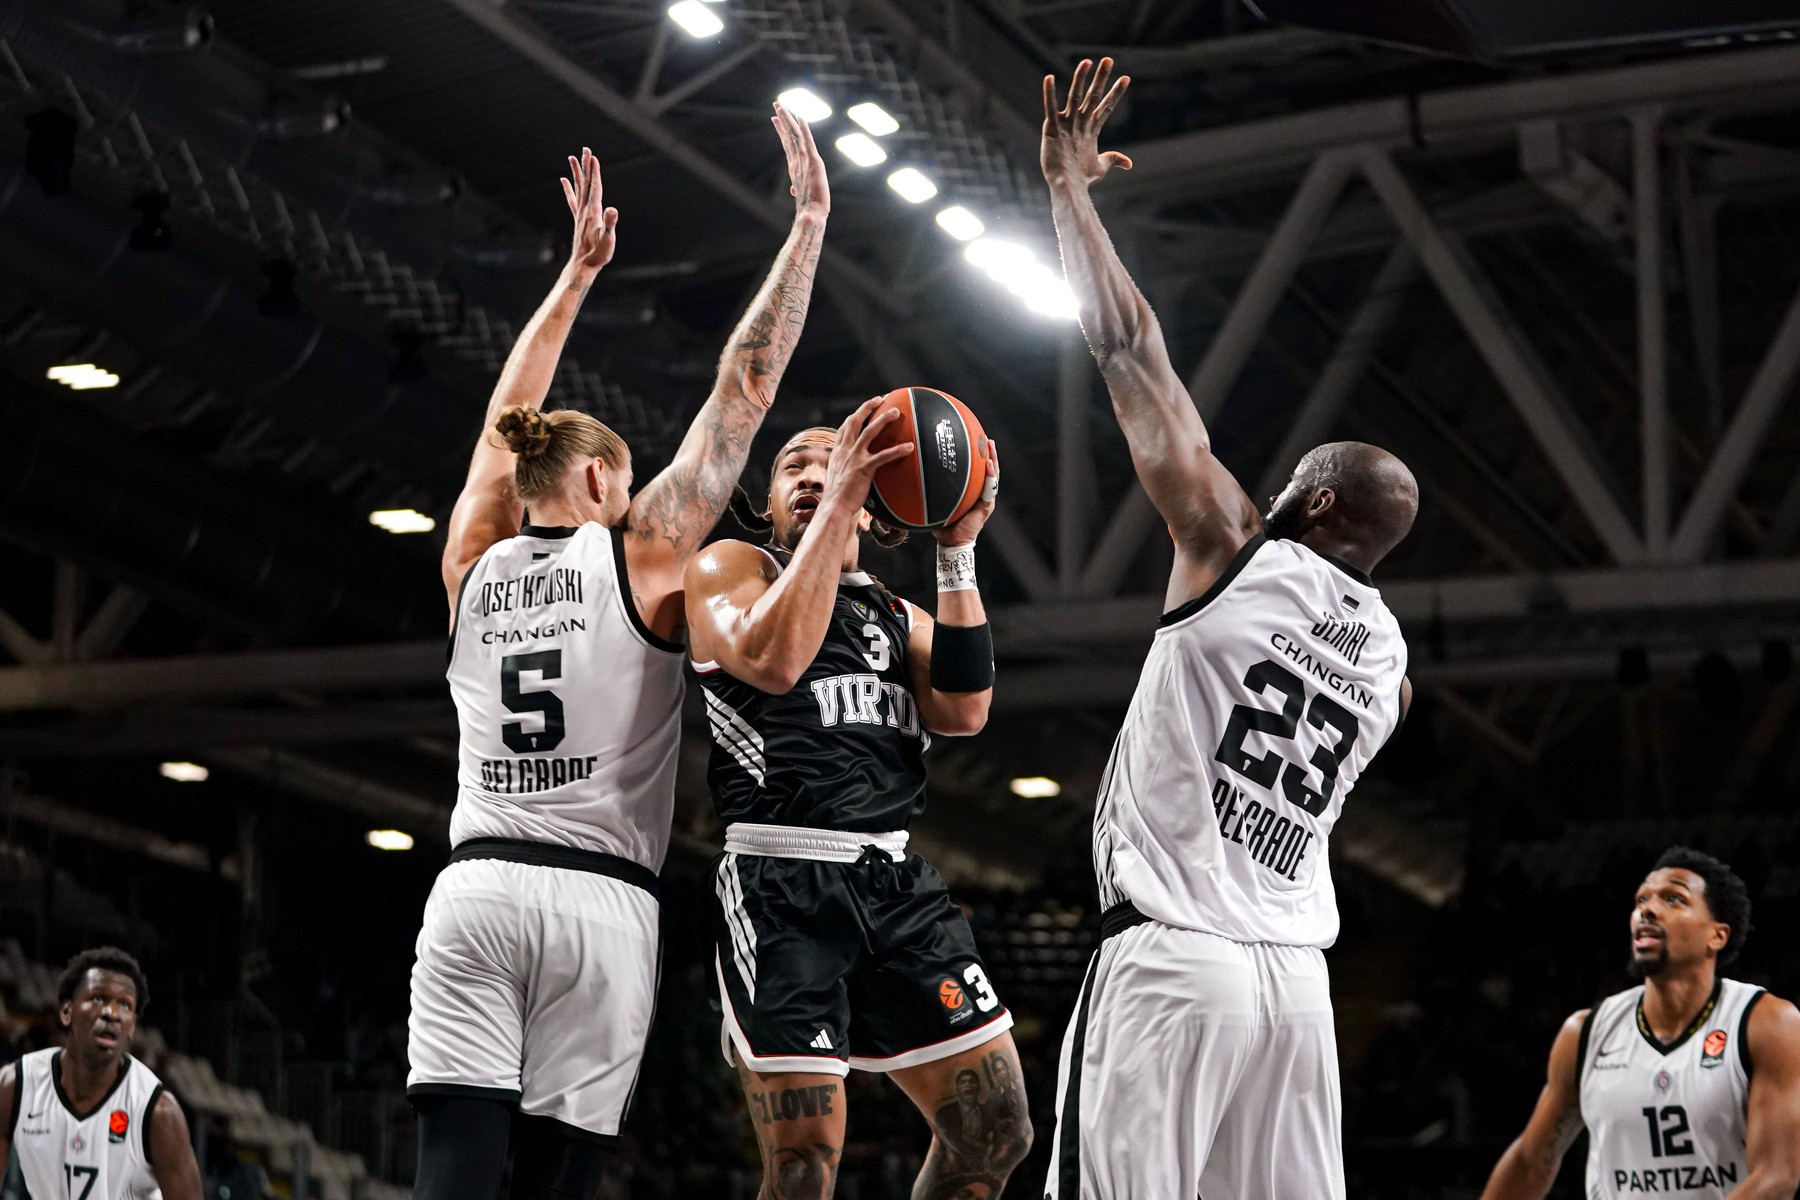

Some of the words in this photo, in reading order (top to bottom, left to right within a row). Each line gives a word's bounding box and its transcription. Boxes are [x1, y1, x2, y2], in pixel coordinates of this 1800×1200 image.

[481, 618, 586, 645] CHANGAN
[862, 623, 891, 672] 3
[1270, 633, 1374, 709] CHANGAN
[501, 649, 565, 754] 5
[1214, 659, 1359, 818] 23
[963, 963, 998, 1012] 3
[1642, 1104, 1695, 1157] 12
[64, 1162, 99, 1200] 17
[1614, 1162, 1738, 1192] PARTIZAN
